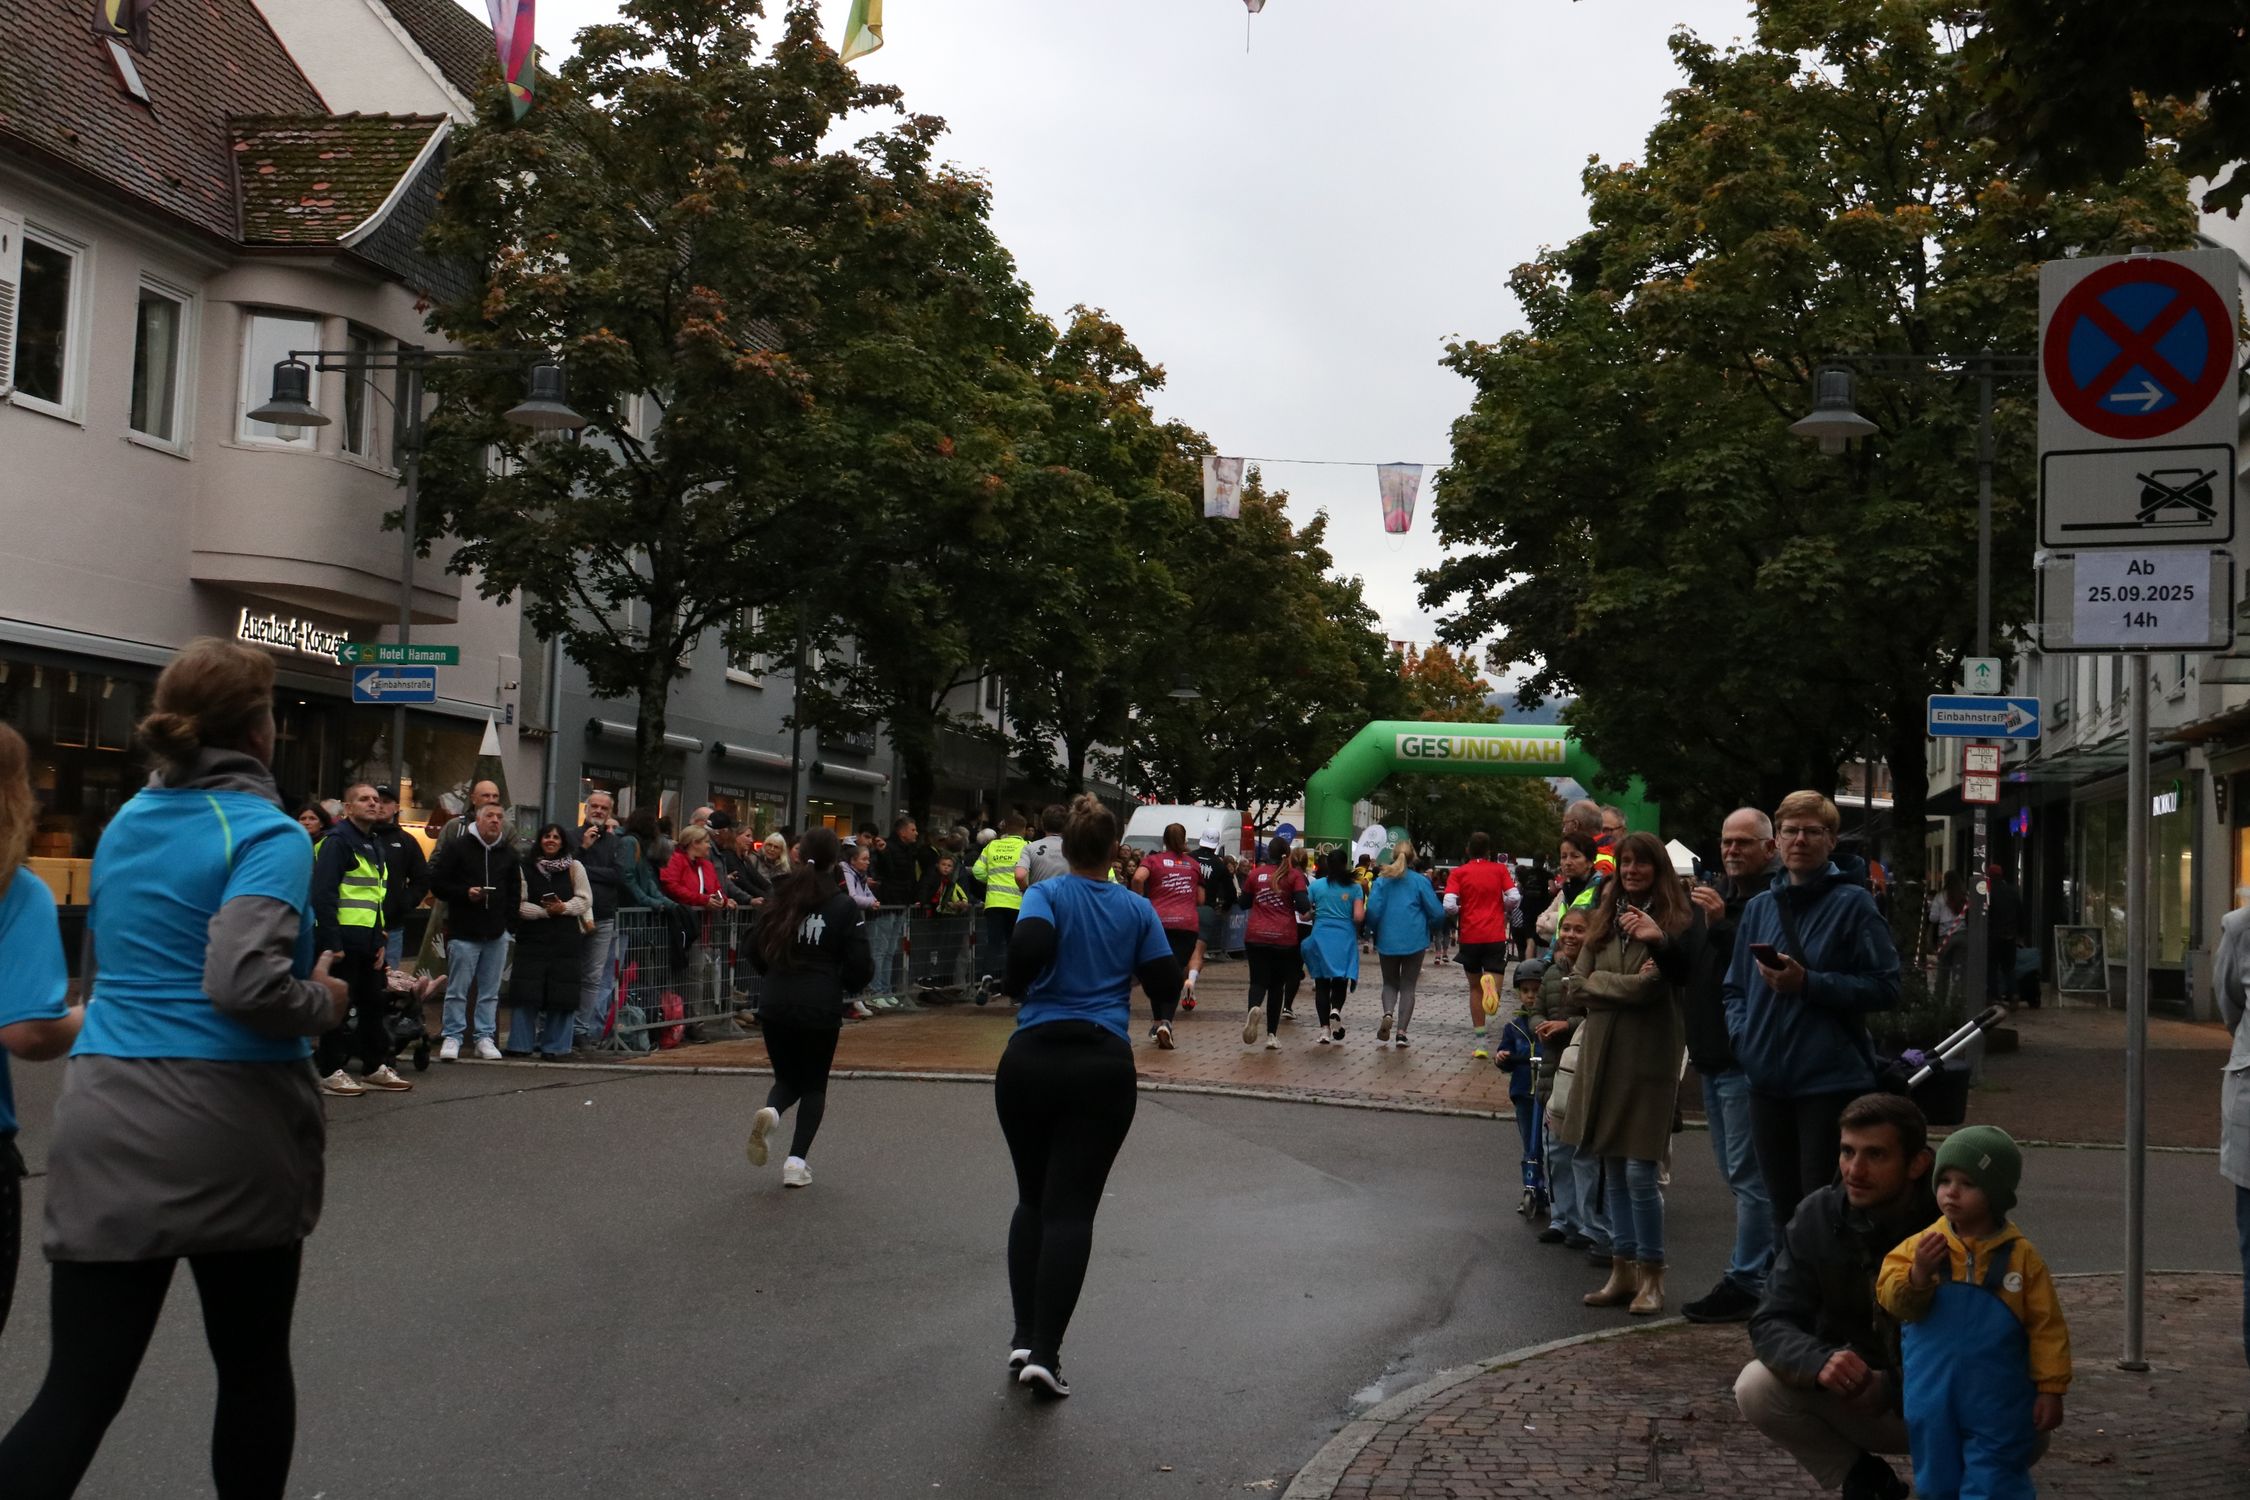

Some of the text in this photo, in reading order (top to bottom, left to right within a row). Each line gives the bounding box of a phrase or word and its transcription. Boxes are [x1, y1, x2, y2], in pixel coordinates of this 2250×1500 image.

[2127, 559, 2155, 575] Ab
[2088, 585, 2195, 602] 25.09.2025
[2123, 612, 2158, 627] 14h
[240, 608, 350, 665] Auenland-Konze
[379, 647, 446, 661] Hotel Hamann
[377, 680, 432, 690] Einbahnstraße
[1401, 737, 1560, 761] GESUNDNAH
[1364, 841, 1380, 849] AOK
[1384, 842, 1396, 850] AO
